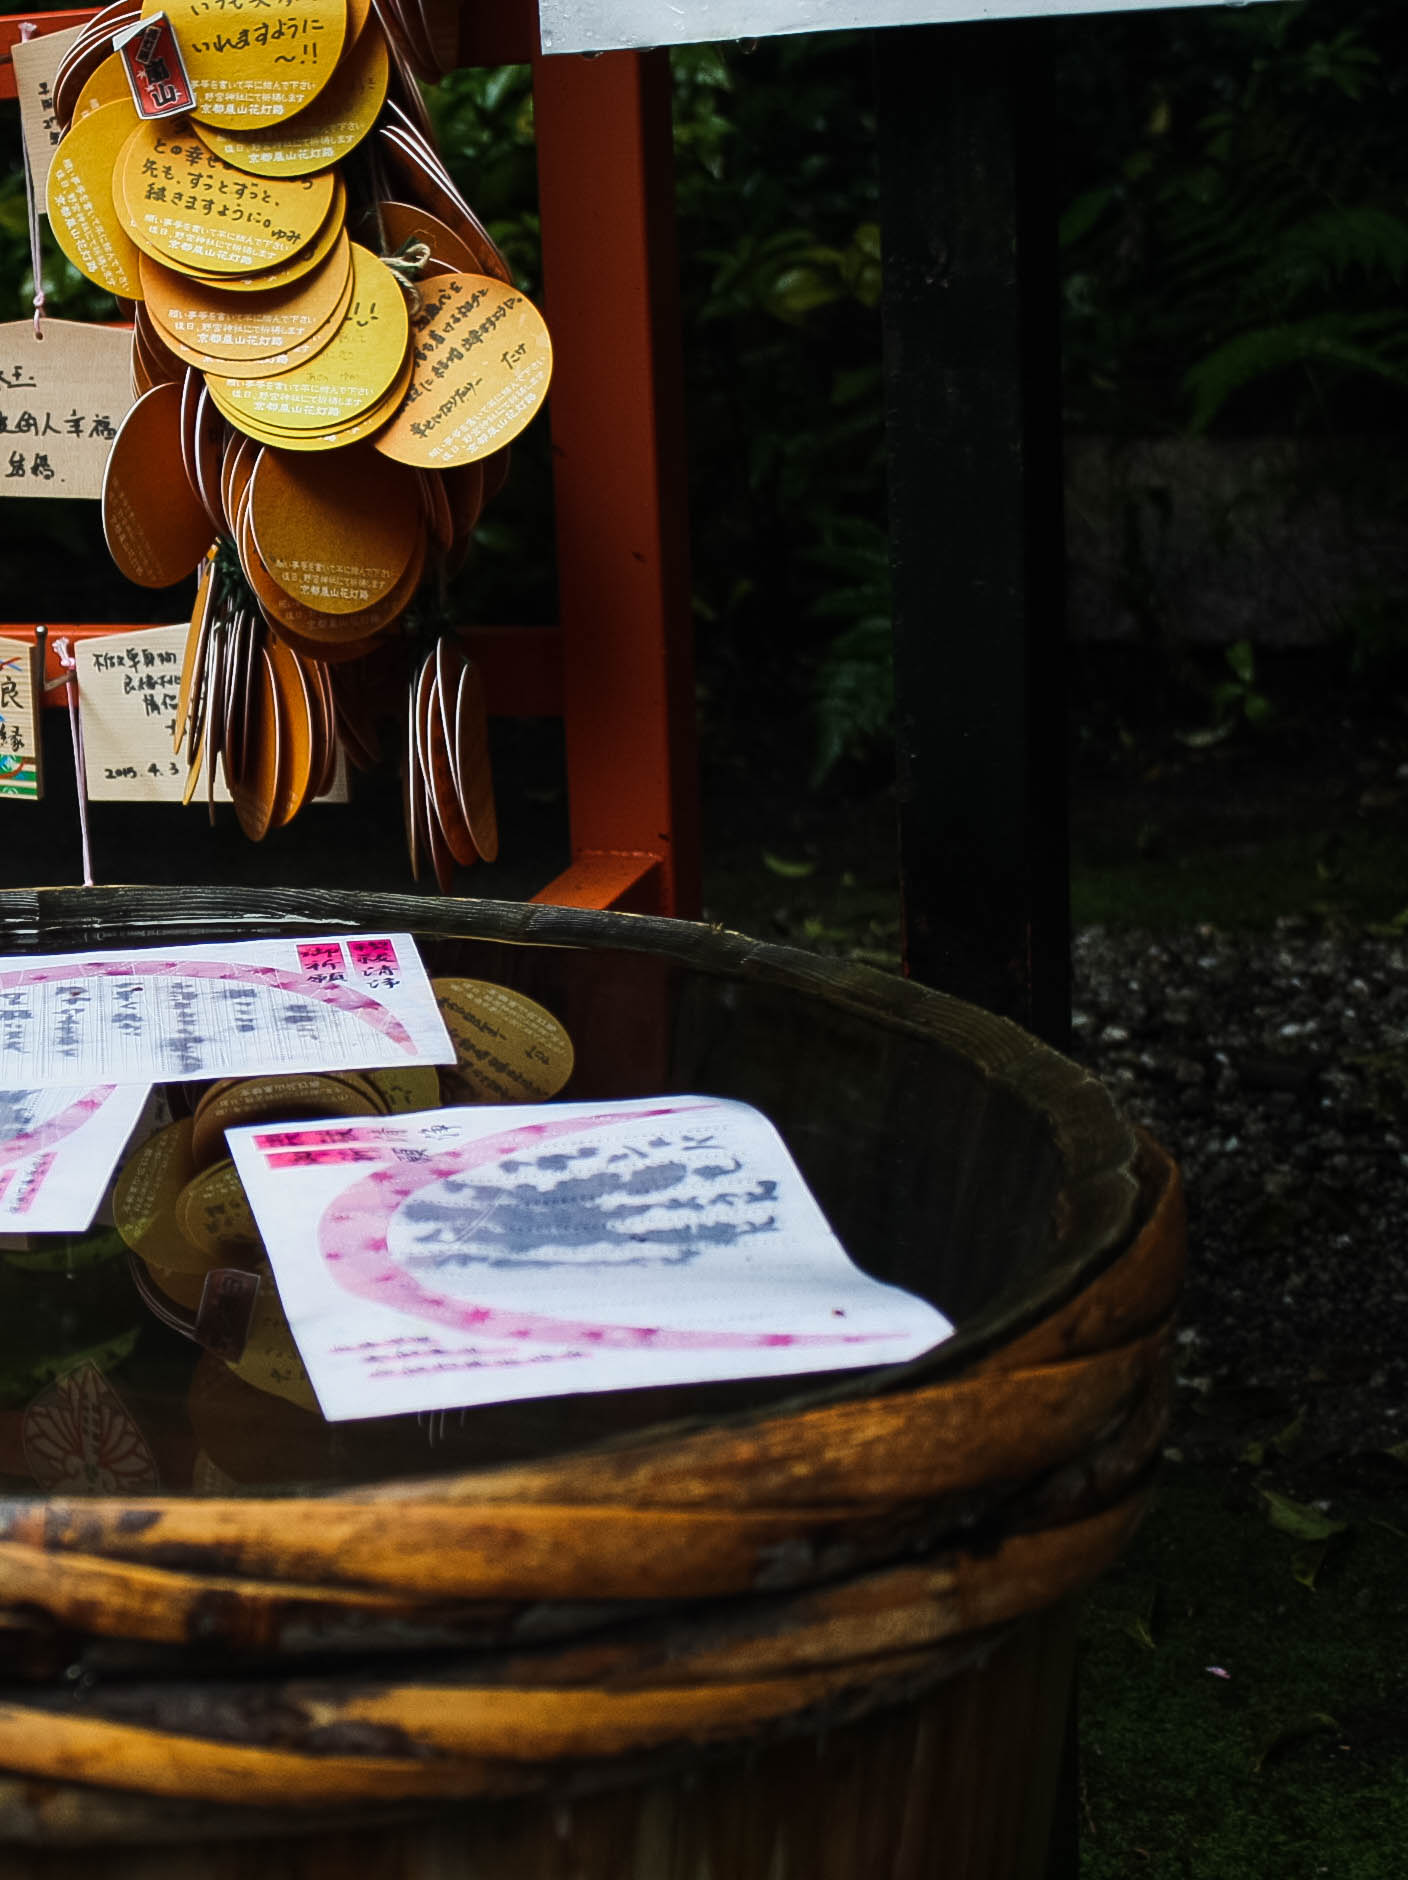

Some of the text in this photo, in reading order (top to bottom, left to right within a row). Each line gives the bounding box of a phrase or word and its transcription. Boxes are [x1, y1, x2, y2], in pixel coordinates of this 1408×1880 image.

[192, 19, 324, 52] いれますように
[170, 762, 180, 776] 3
